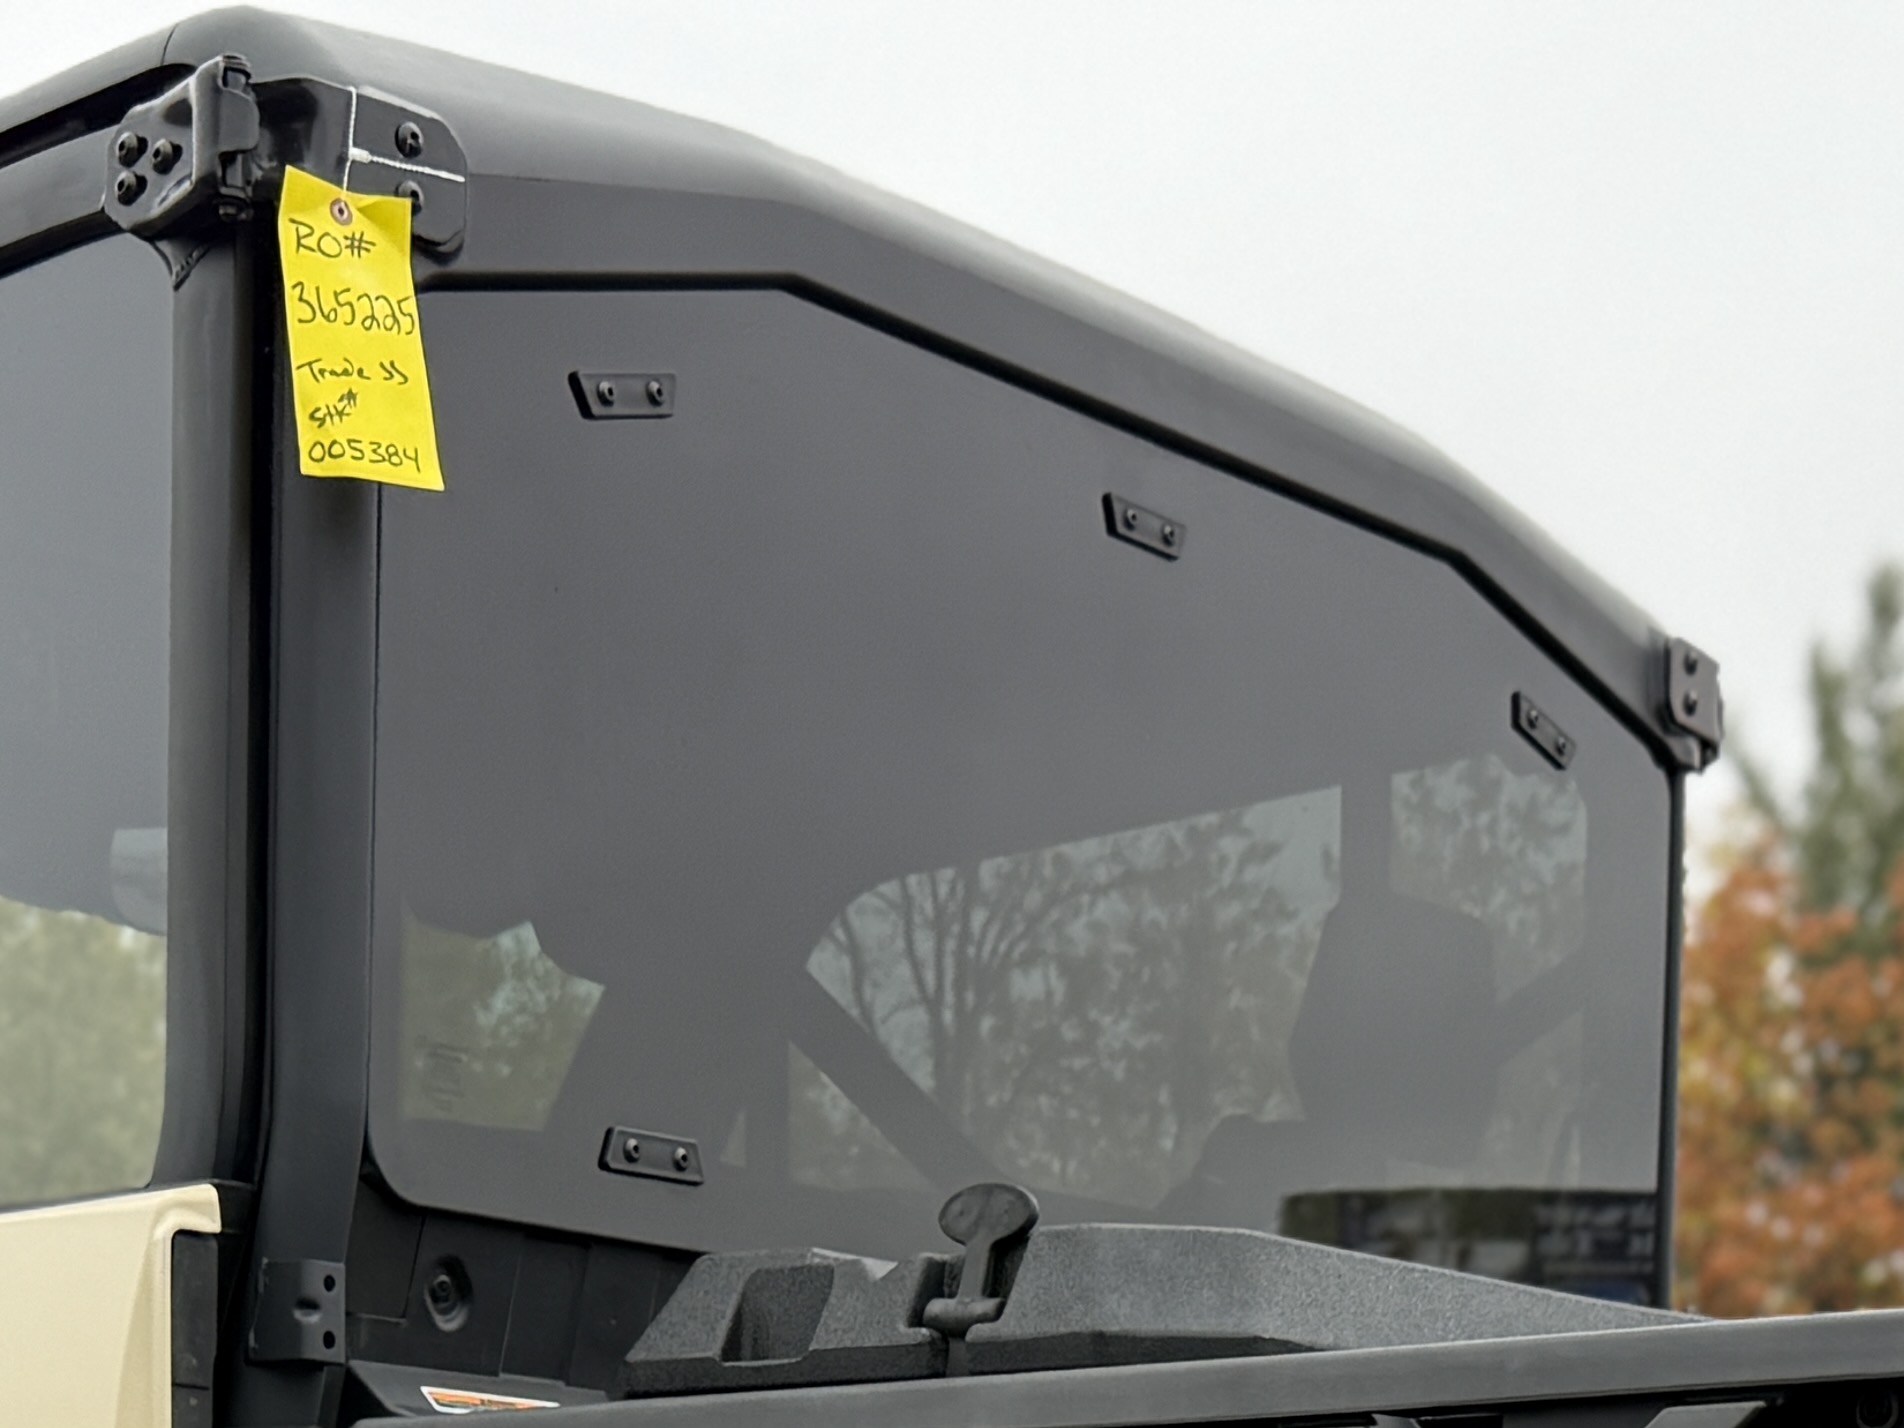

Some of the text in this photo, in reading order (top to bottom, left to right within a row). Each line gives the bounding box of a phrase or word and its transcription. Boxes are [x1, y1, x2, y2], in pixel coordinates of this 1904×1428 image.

[289, 218, 376, 258] RO#
[291, 281, 416, 336] 365225
[308, 437, 421, 474] 005384
